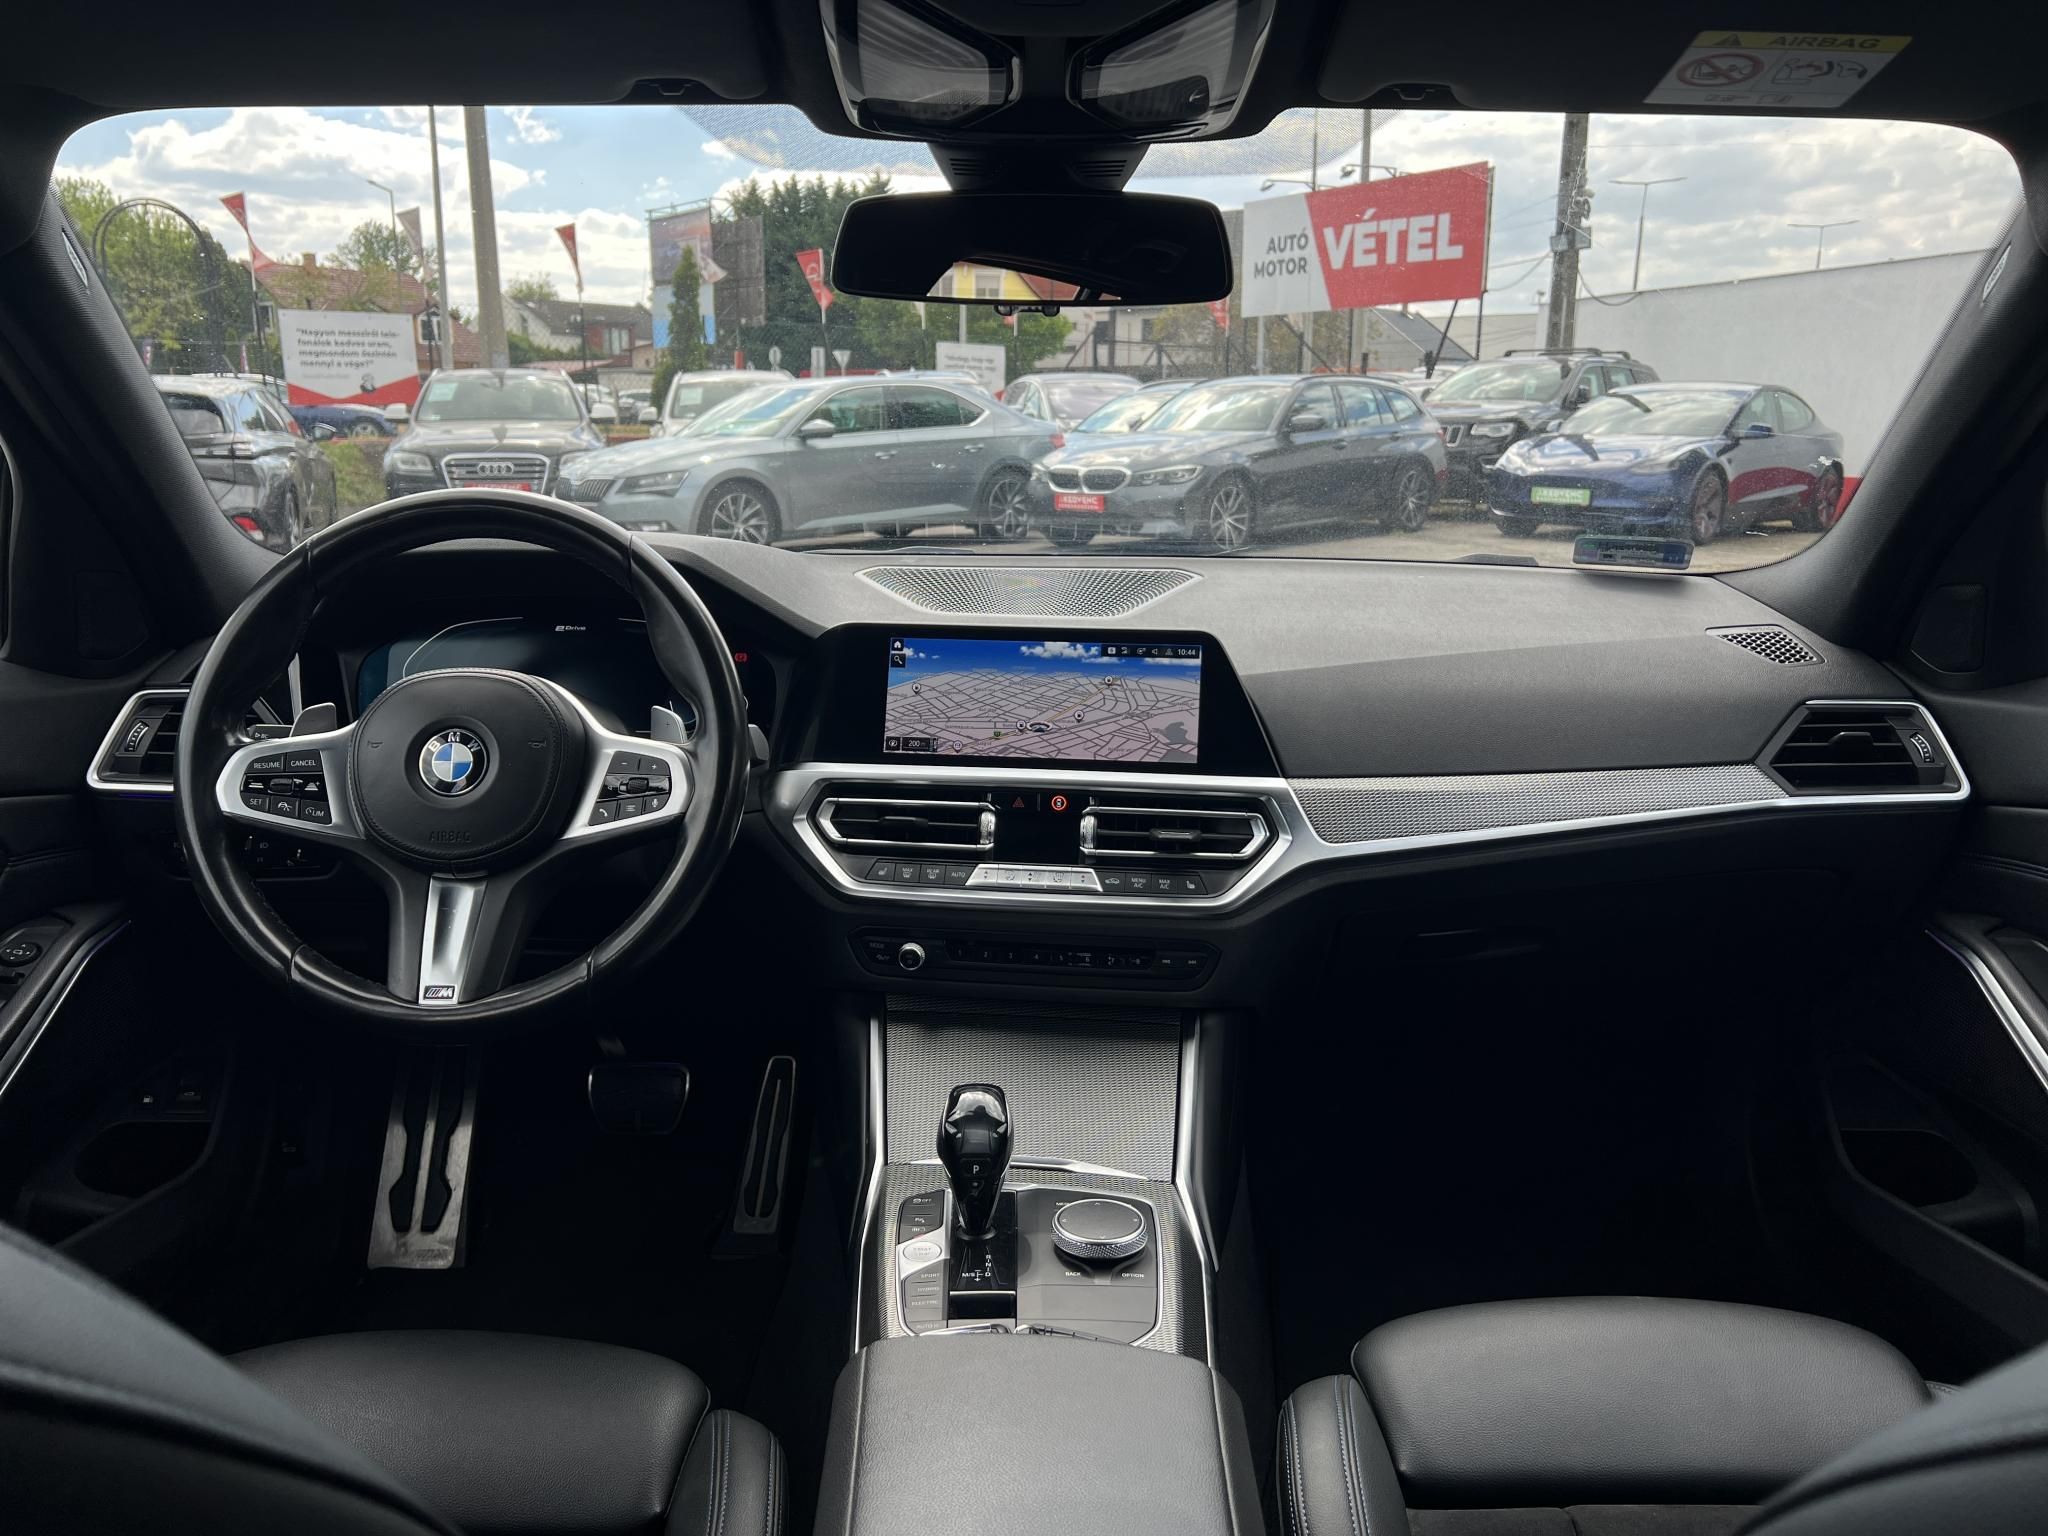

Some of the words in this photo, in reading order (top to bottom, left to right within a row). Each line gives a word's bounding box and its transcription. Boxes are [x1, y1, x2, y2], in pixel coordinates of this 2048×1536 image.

[1766, 36, 1881, 49] AIRBAG
[1266, 227, 1309, 255] AUTÓ
[1323, 208, 1463, 270] VÉTEL
[1254, 256, 1307, 279] MOTOR
[1177, 648, 1196, 656] 10:44
[428, 731, 481, 753] BMW
[253, 761, 281, 769] RESUME
[290, 759, 316, 767] CANCEL
[428, 830, 473, 843] AIRBAG
[972, 1165, 980, 1174] P
